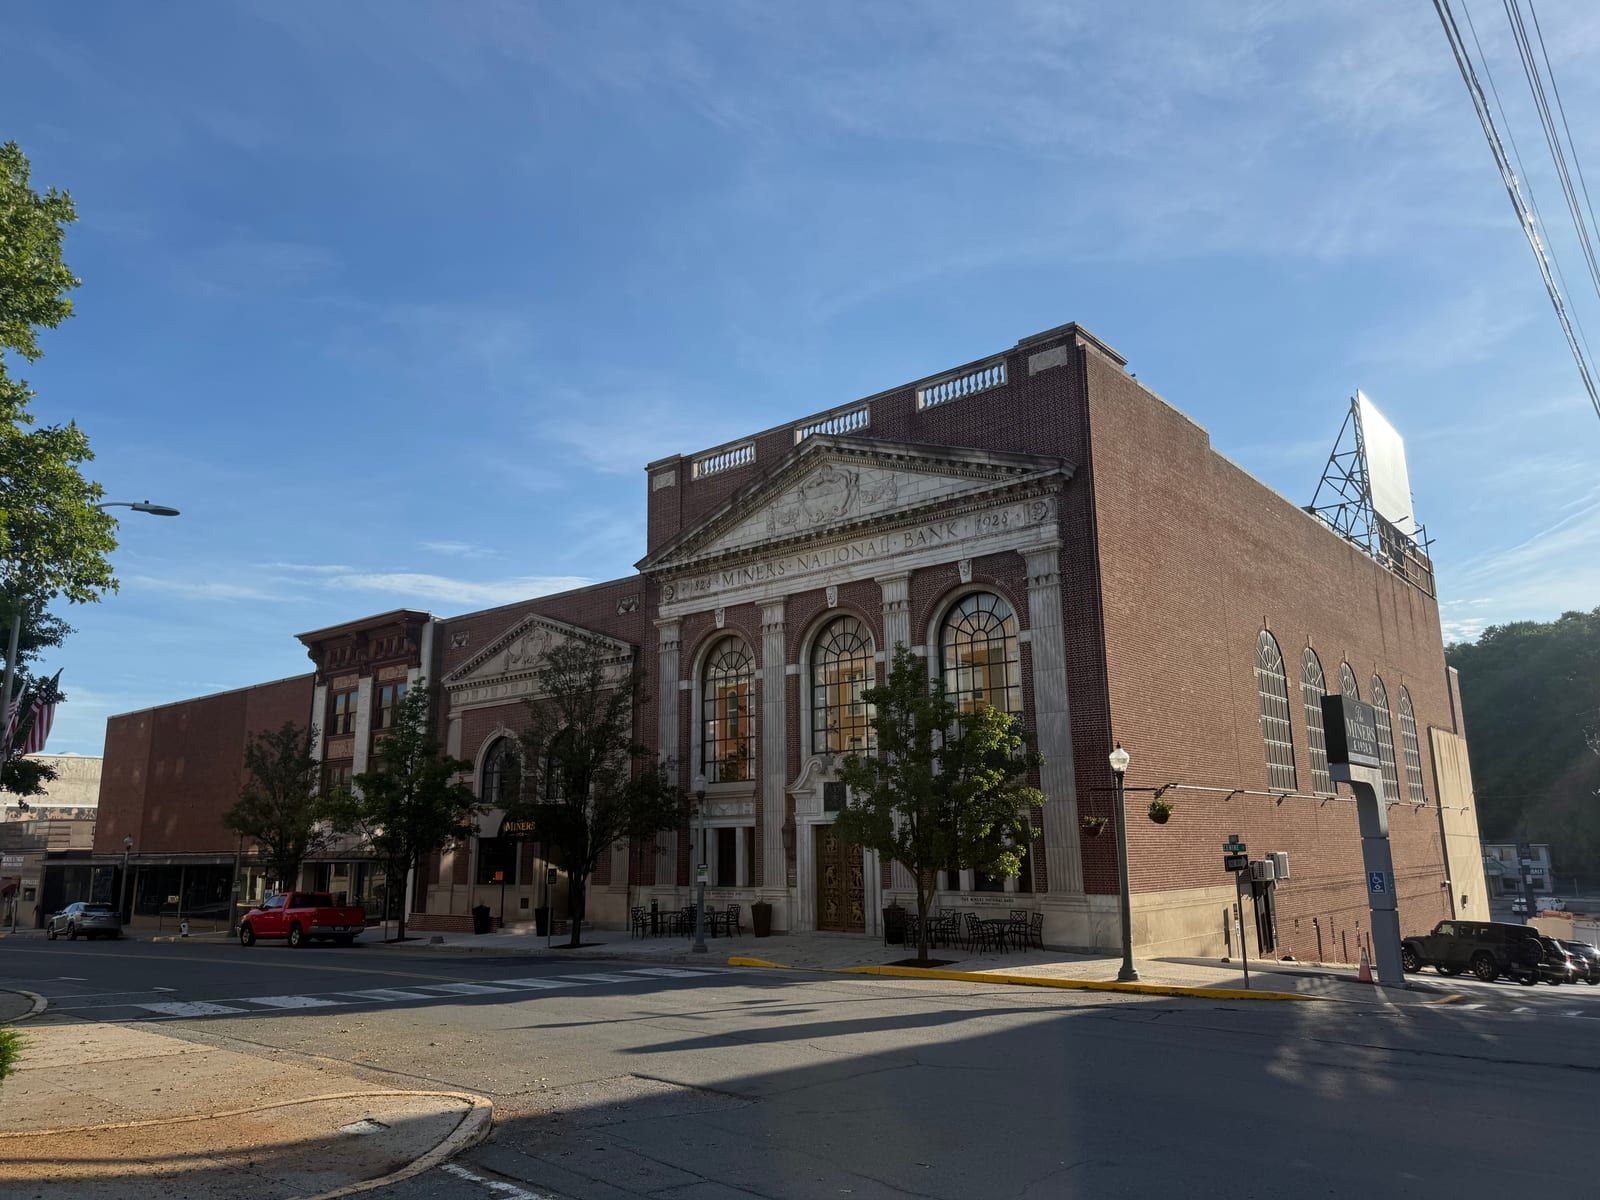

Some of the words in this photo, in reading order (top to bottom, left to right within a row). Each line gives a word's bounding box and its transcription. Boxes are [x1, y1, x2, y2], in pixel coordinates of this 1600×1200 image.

[722, 561, 785, 588] MINERS
[797, 536, 891, 569] NATIONAL
[903, 522, 958, 548] BANK
[1346, 717, 1377, 743] MINERS
[503, 821, 536, 832] MINERS
